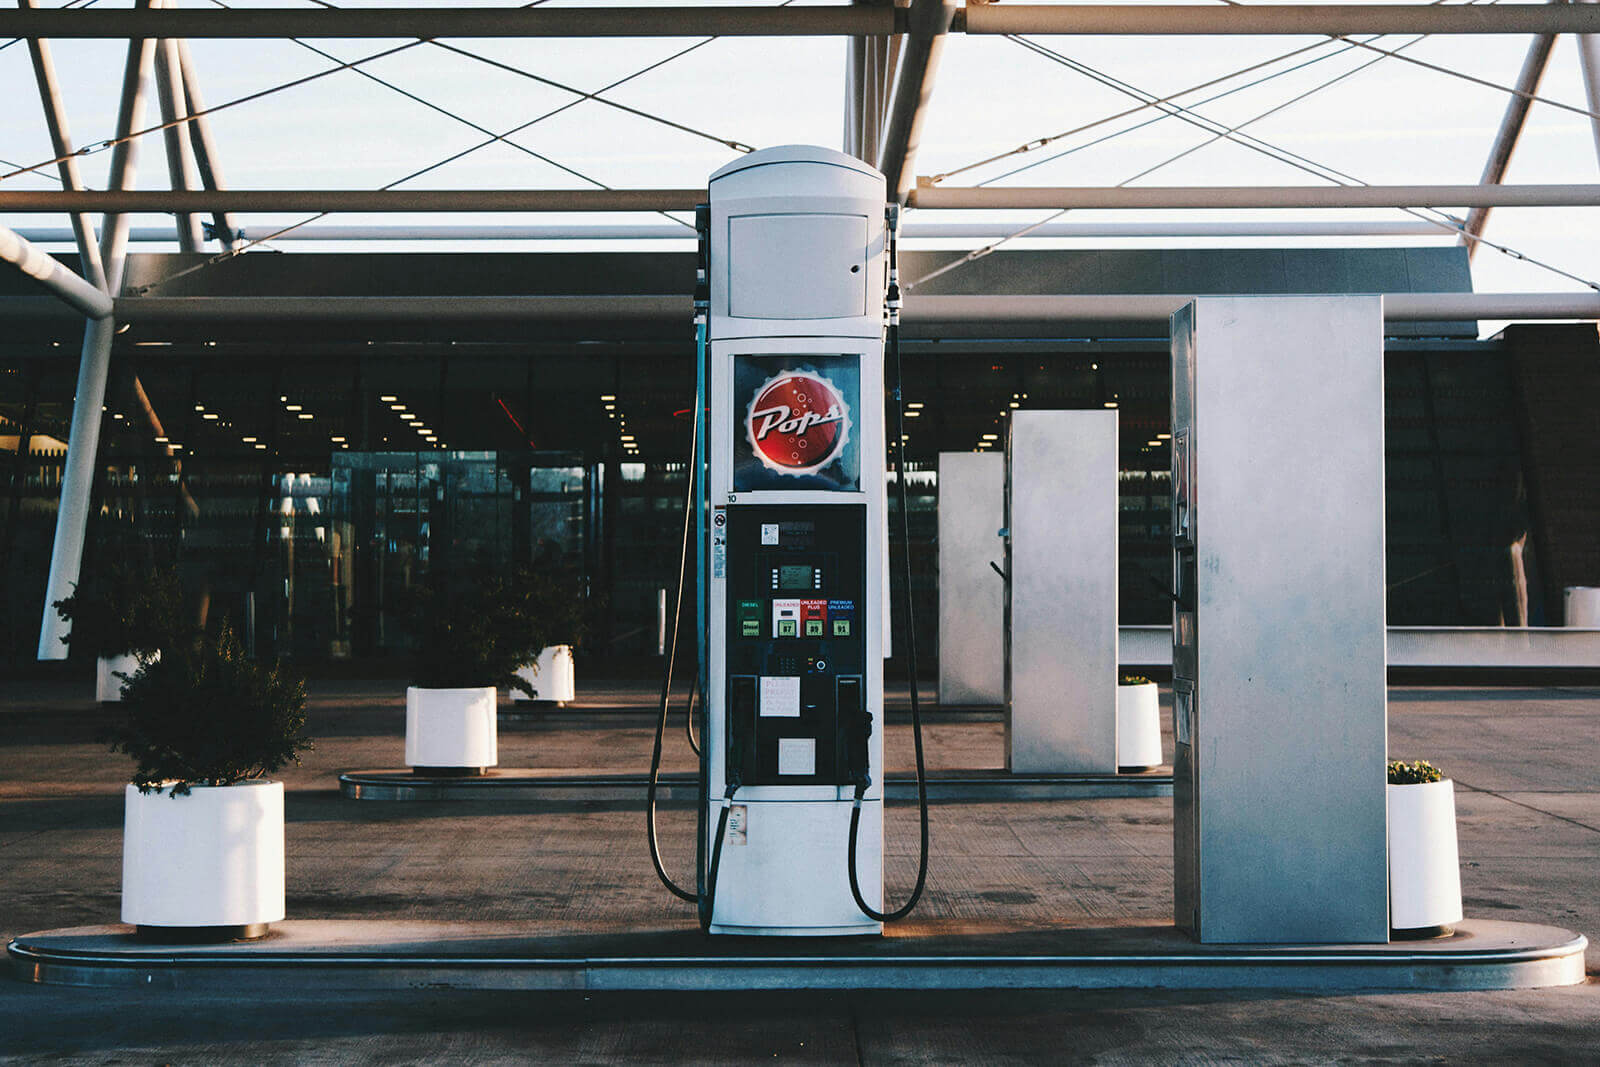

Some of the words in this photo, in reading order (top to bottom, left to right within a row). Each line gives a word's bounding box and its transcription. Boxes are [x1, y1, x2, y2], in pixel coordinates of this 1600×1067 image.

[753, 404, 844, 440] Pops
[728, 494, 737, 503] 10
[783, 625, 792, 633] 87
[810, 625, 819, 633] 89
[837, 625, 846, 633] 91
